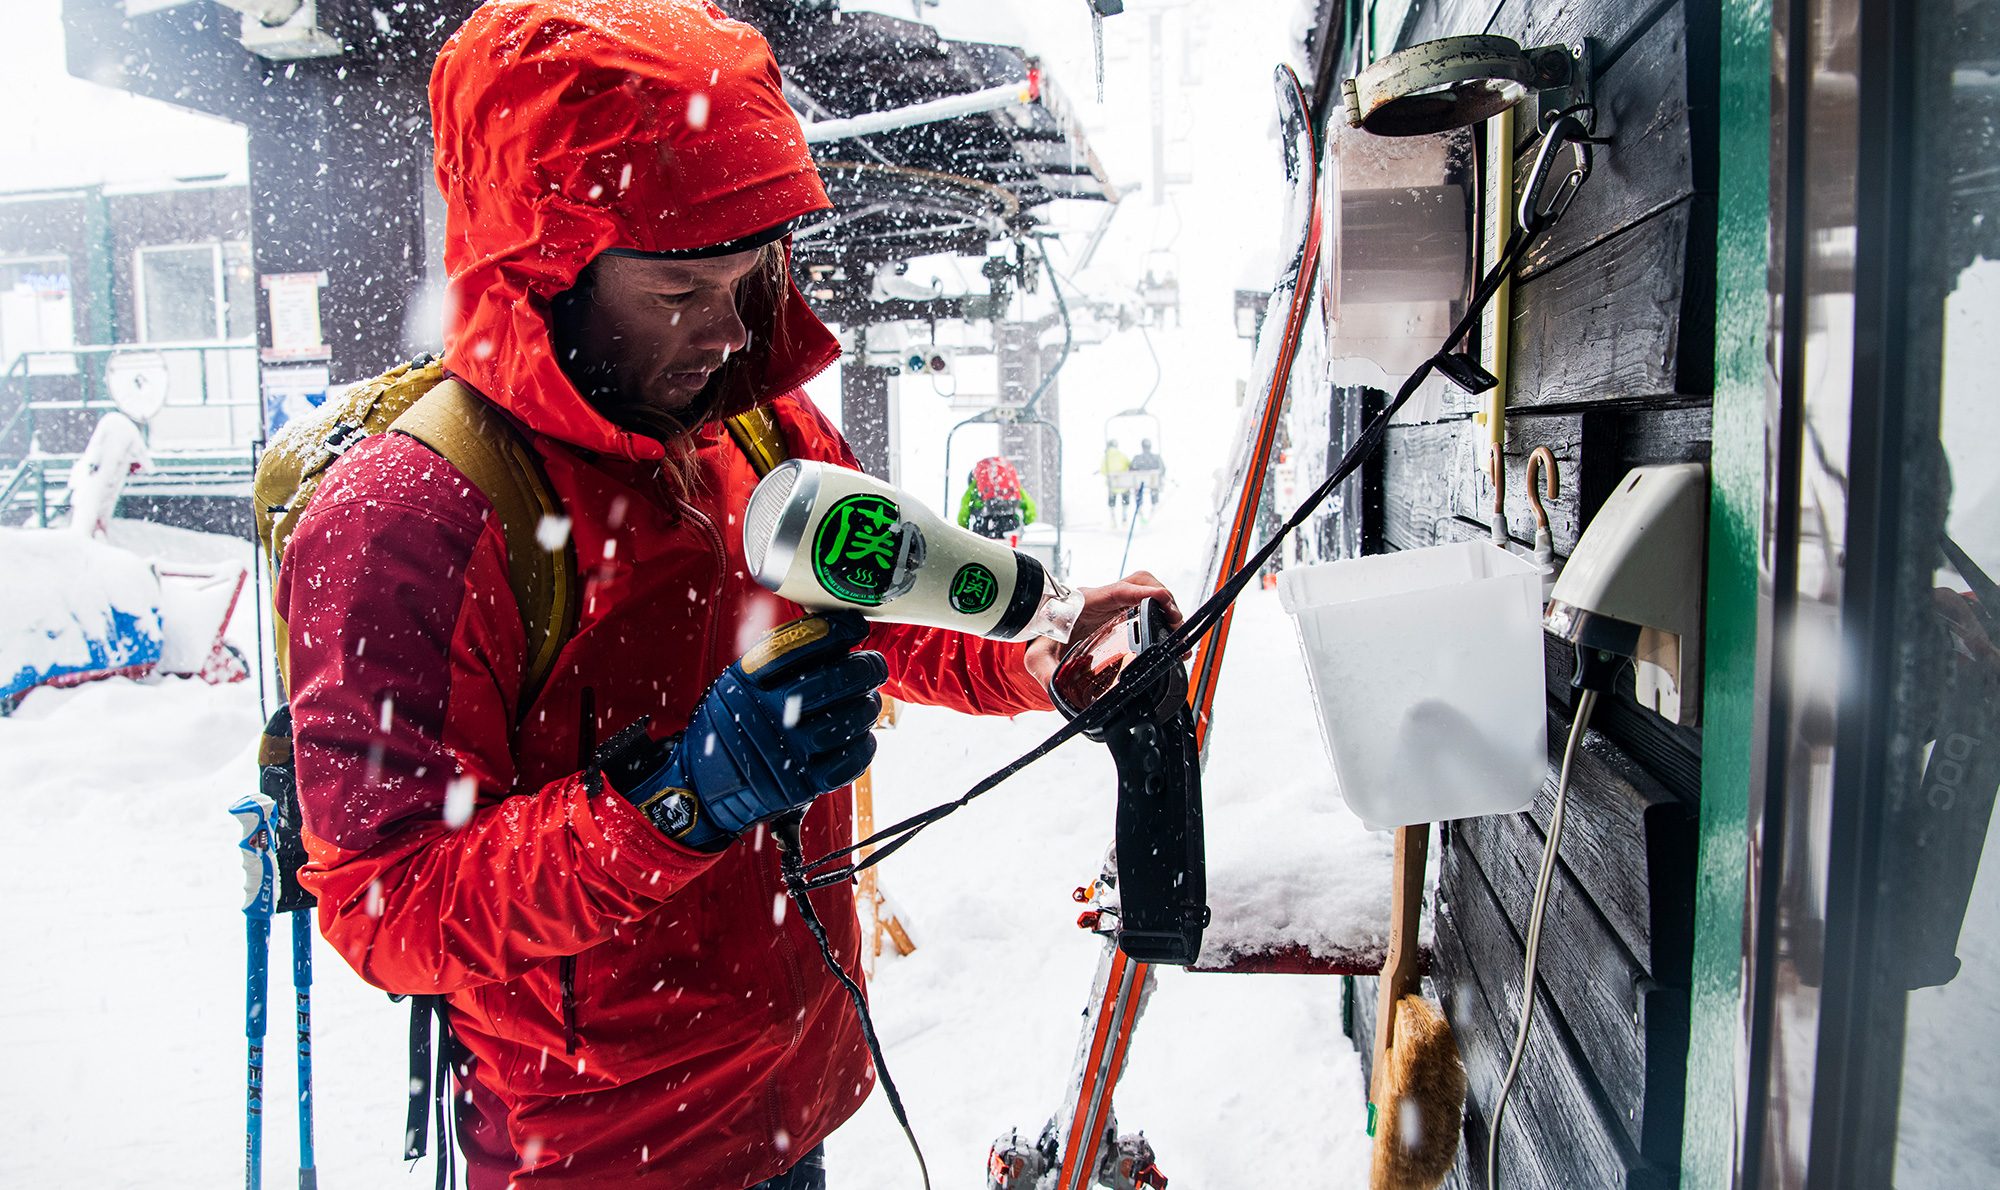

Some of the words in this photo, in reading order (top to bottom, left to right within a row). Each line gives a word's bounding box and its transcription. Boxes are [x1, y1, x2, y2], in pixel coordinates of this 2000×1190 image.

[260, 874, 272, 913] LEKI
[296, 992, 311, 1057] LEKI
[248, 1044, 263, 1117] LEKI
